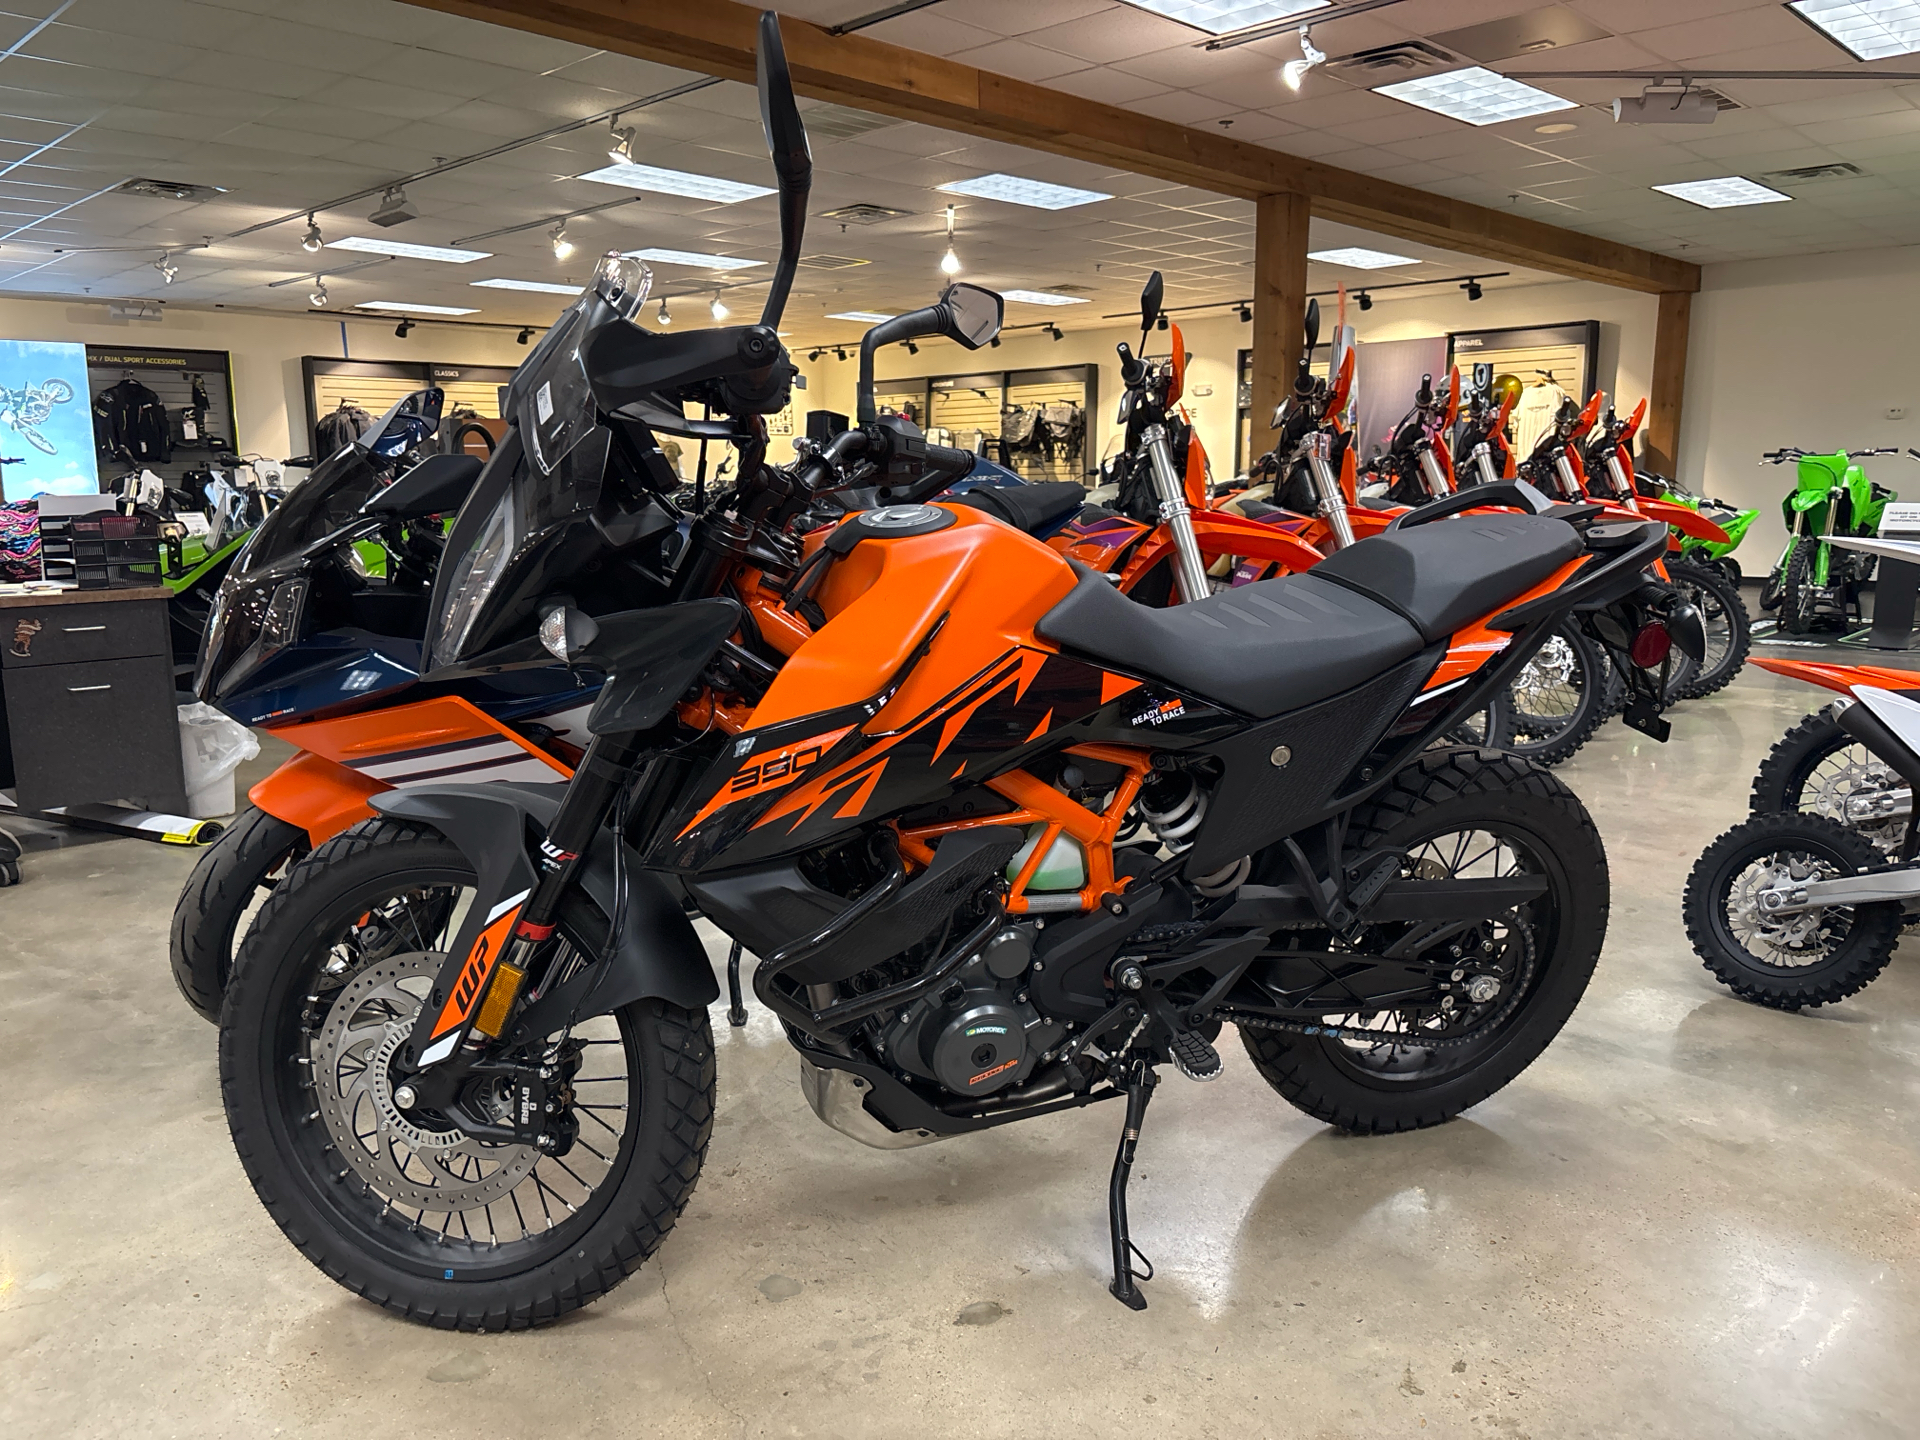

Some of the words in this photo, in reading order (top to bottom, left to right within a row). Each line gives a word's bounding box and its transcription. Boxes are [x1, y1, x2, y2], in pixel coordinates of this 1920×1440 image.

[1454, 339, 1484, 347] APPAREL
[104, 355, 121, 363] DUAL
[123, 356, 144, 364] SPORT
[146, 357, 187, 366] ACCESSORIES
[434, 370, 459, 378] CLASSICS
[1131, 708, 1159, 726] READY
[1150, 715, 1163, 726] TO
[1162, 706, 1186, 721] RACE
[540, 837, 580, 861] WP
[456, 935, 489, 1016] WP
[976, 1026, 1006, 1034] MOTOREX
[520, 1086, 530, 1125] BYBRE
